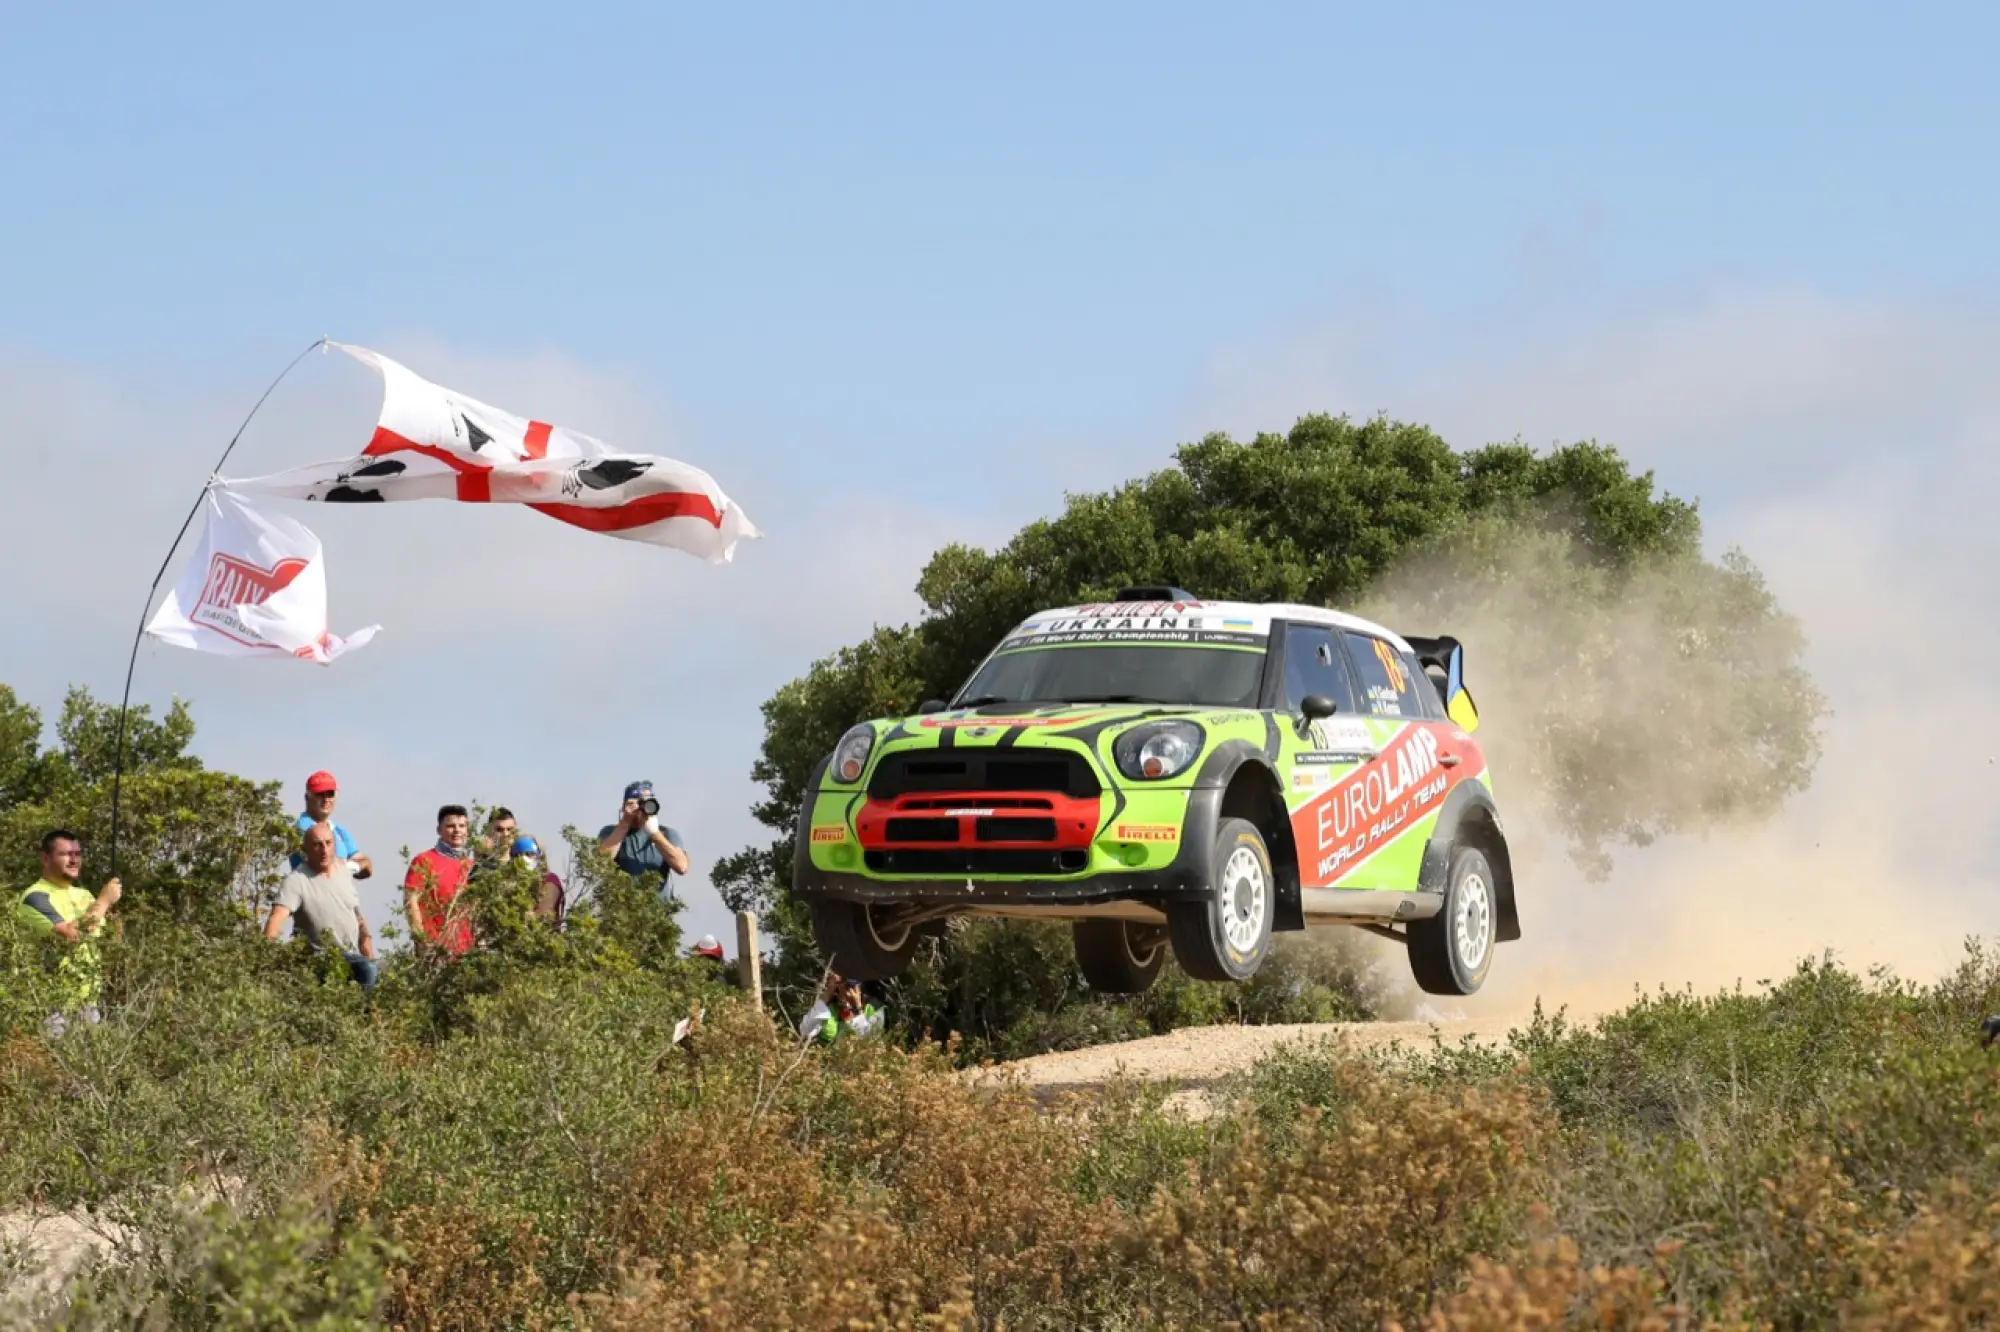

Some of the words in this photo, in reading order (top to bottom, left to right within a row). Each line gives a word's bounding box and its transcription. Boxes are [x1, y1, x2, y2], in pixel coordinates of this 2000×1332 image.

[203, 560, 265, 609] RALLY
[1049, 617, 1203, 632] UKRAINE
[1047, 633, 1076, 643] World
[1077, 632, 1106, 642] Rally
[1108, 632, 1190, 642] Championship
[1317, 726, 1439, 850] EUROLAMP
[1118, 825, 1176, 841] PIRELLI
[1317, 836, 1364, 878] WORLD
[1369, 801, 1409, 839] RALLY
[1412, 774, 1448, 810] TEAM
[813, 828, 845, 841] PIRELLI
